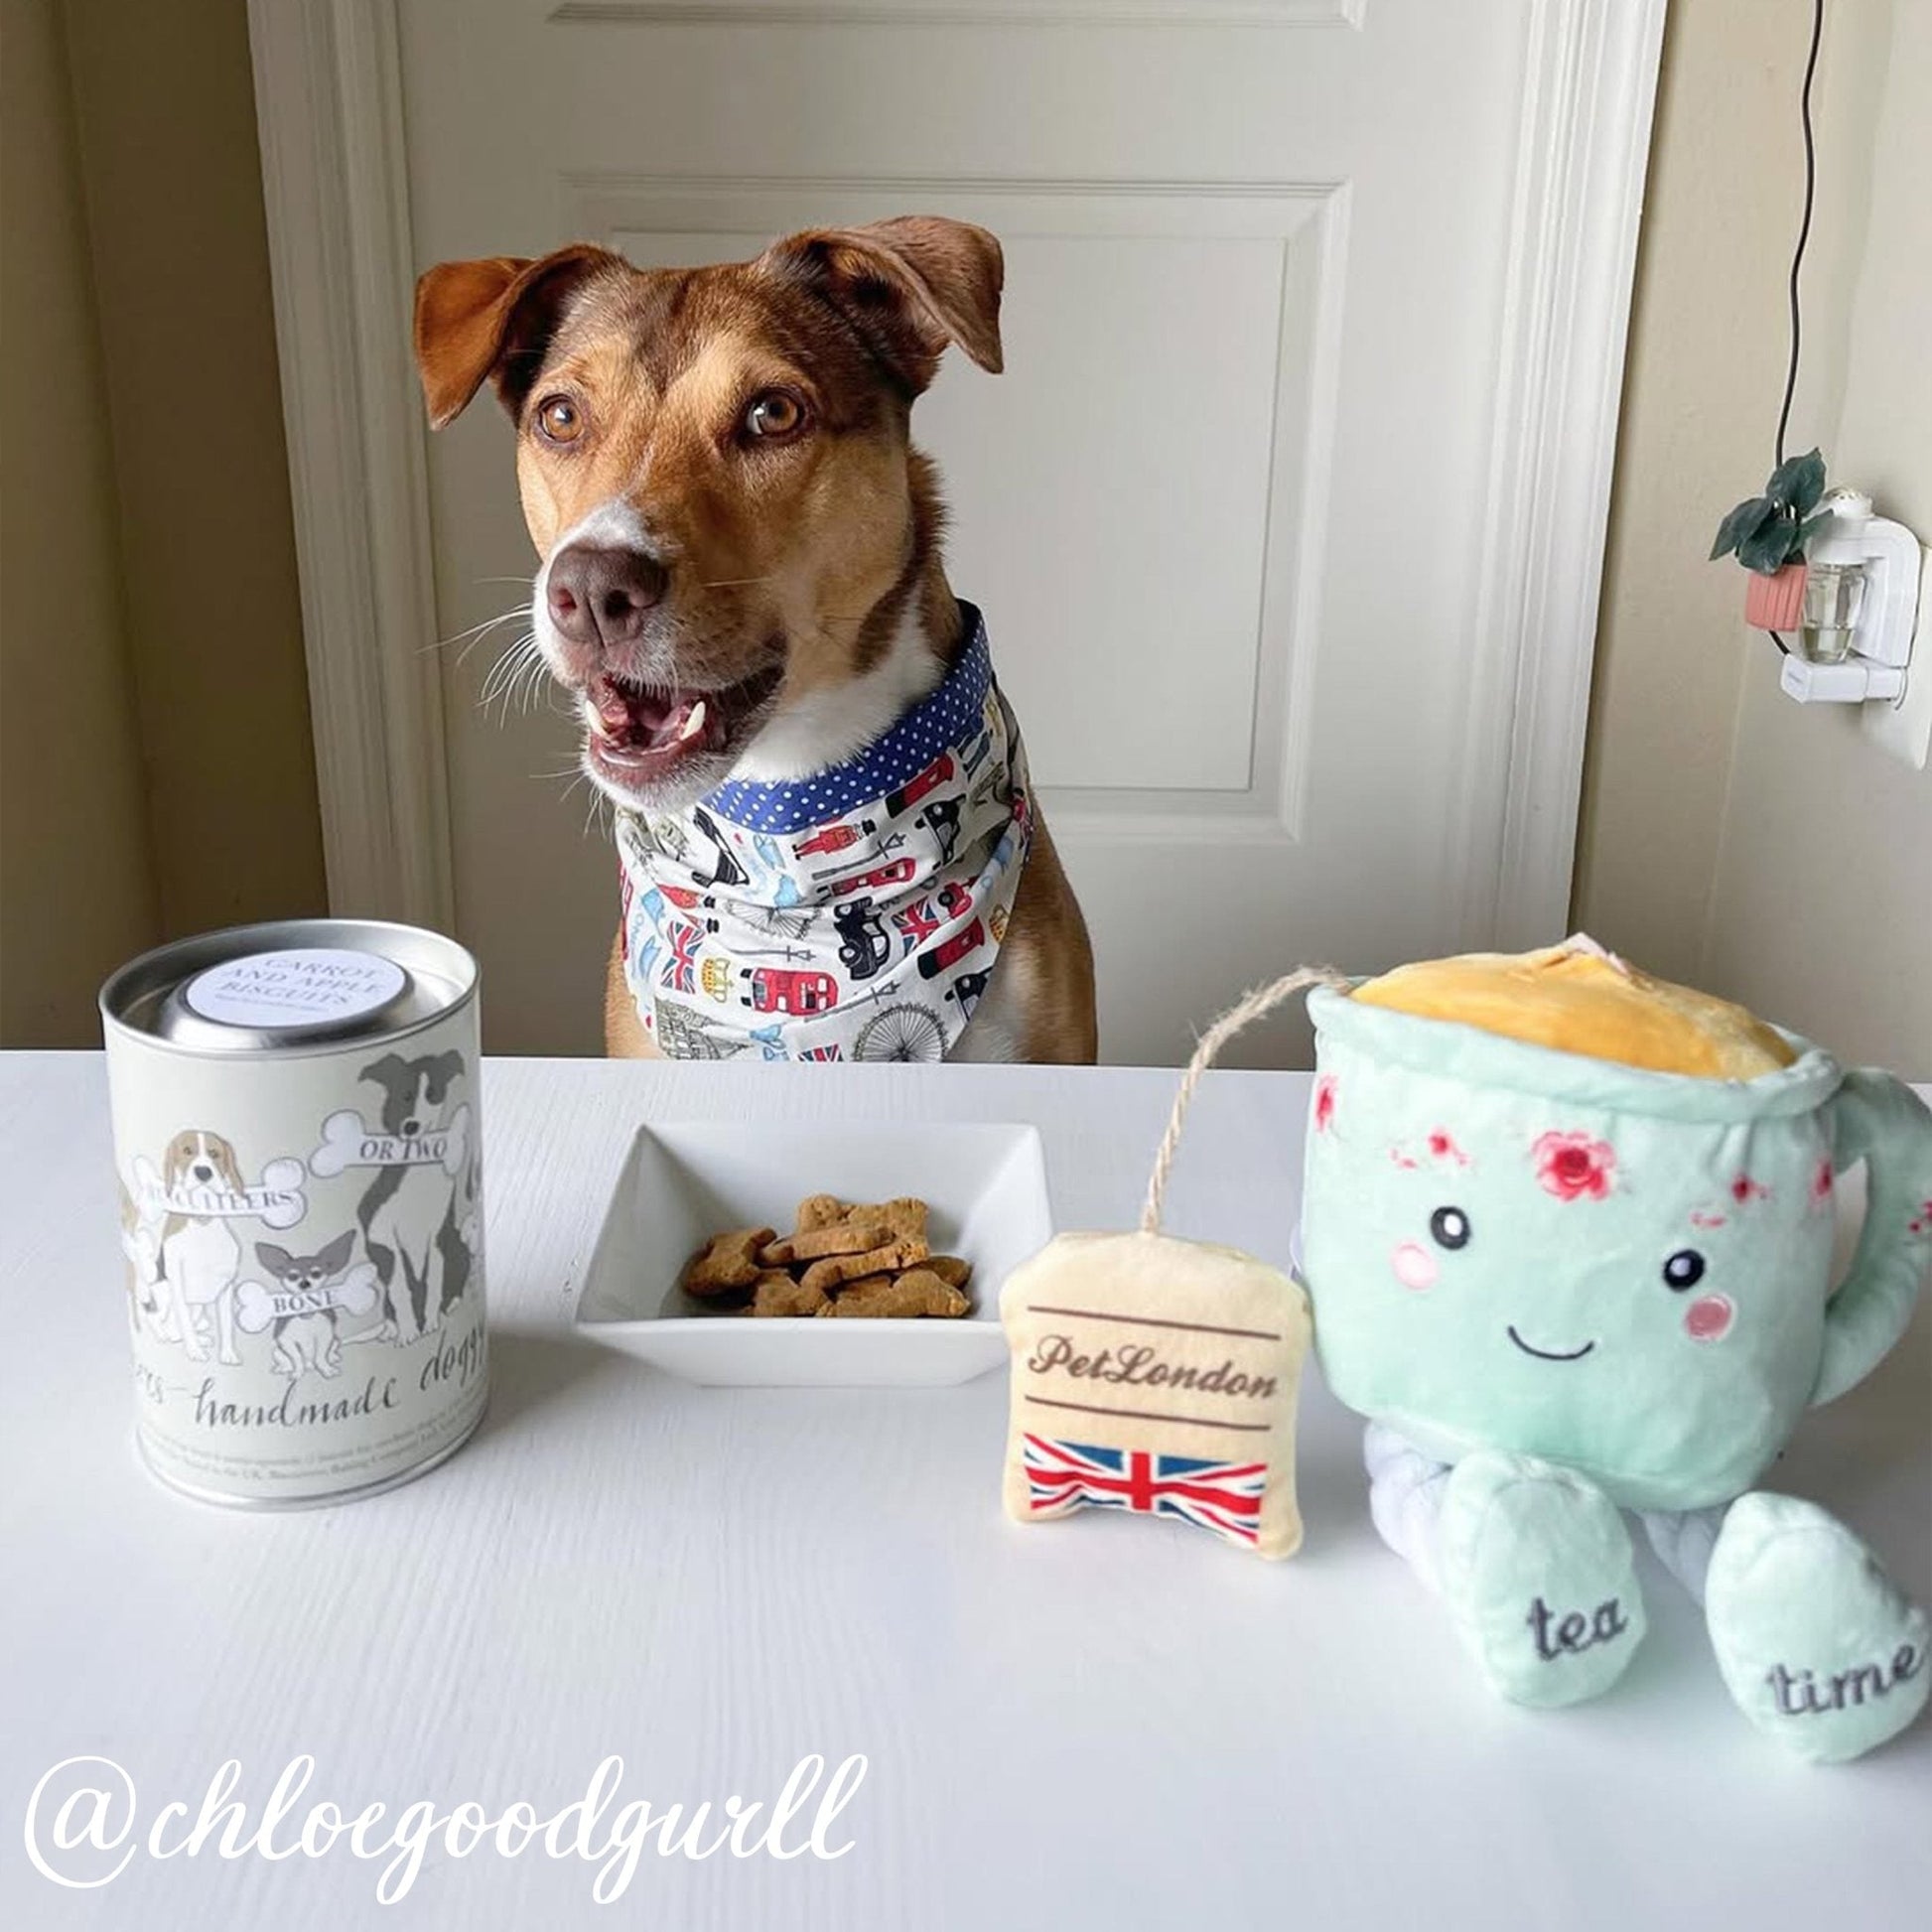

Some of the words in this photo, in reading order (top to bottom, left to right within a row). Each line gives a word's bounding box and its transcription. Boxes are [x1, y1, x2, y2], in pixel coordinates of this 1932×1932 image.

[222, 968, 288, 983] AND
[299, 977, 385, 994] APPLE
[265, 958, 381, 979] CARROT
[359, 1139, 394, 1161] OR
[401, 1138, 448, 1161] TWO
[1028, 1333, 1279, 1399] PetLondon
[193, 1376, 400, 1428] handmade
[1527, 1596, 1629, 1662] tea
[1765, 1643, 1926, 1717] time
